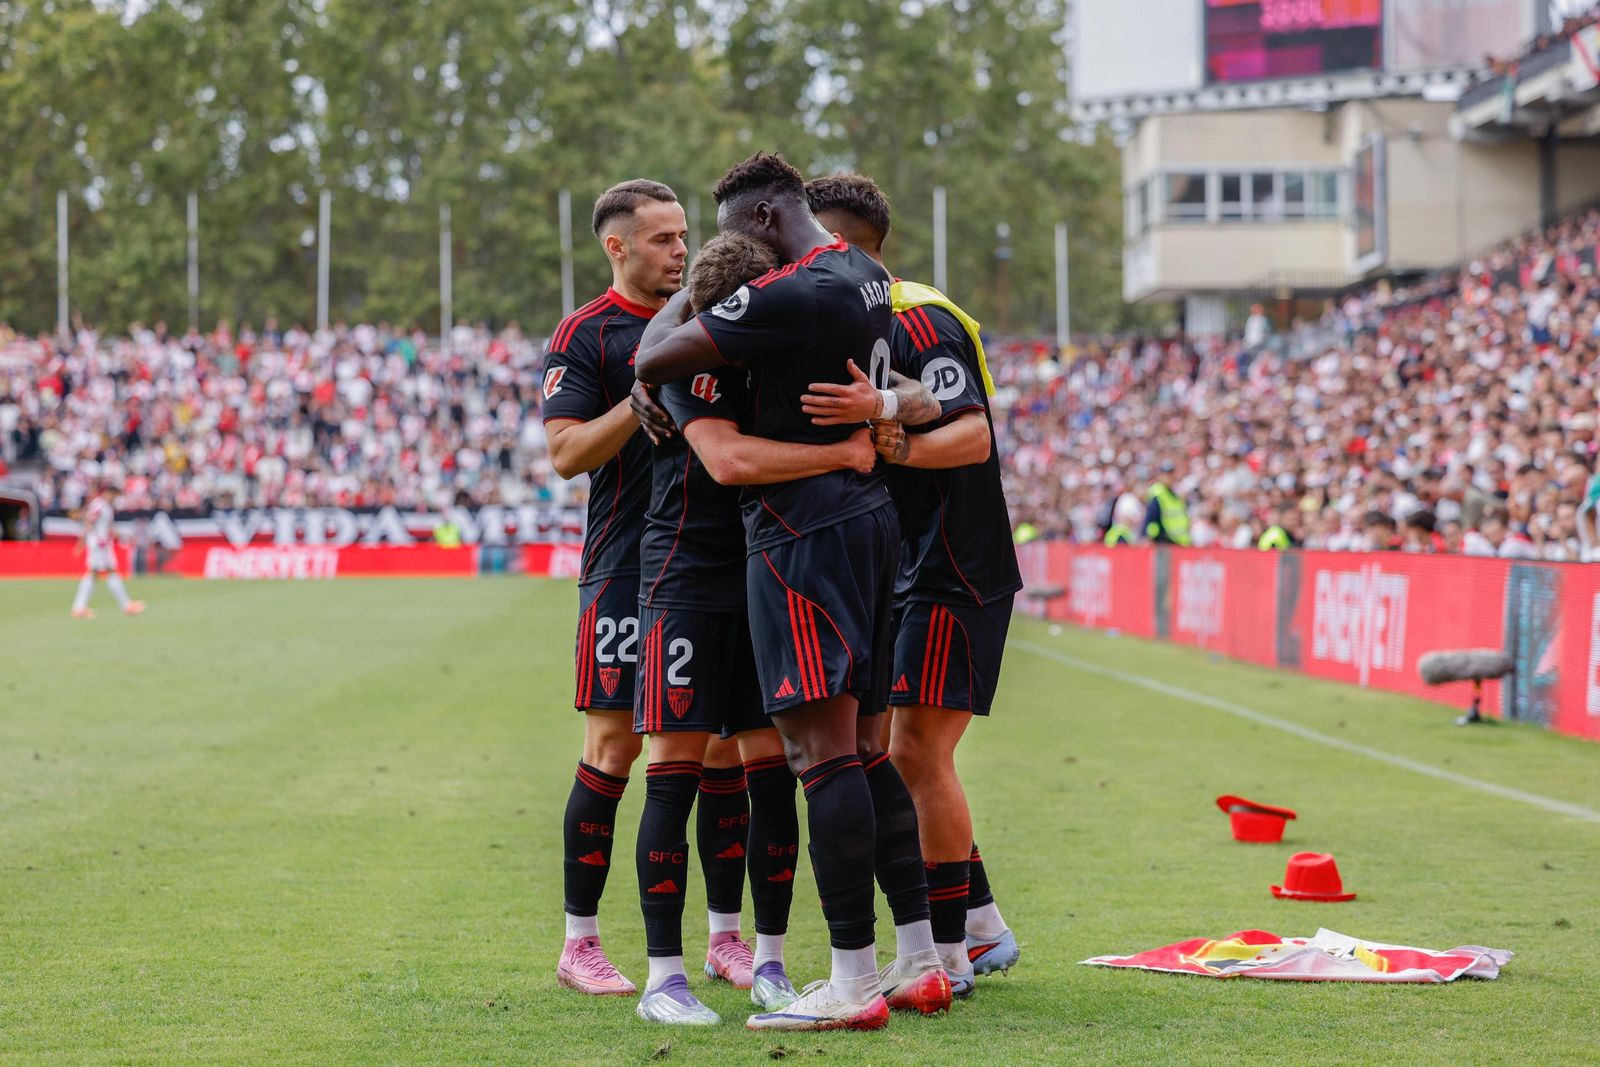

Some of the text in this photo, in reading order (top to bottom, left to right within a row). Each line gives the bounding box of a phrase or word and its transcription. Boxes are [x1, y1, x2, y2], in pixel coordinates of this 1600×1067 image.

[931, 366, 960, 394] JD
[220, 507, 417, 550] VIDA
[595, 616, 639, 663] 22
[667, 638, 693, 686] 2
[579, 822, 610, 836] SFC
[648, 850, 685, 864] SFC
[767, 844, 797, 857] SFC
